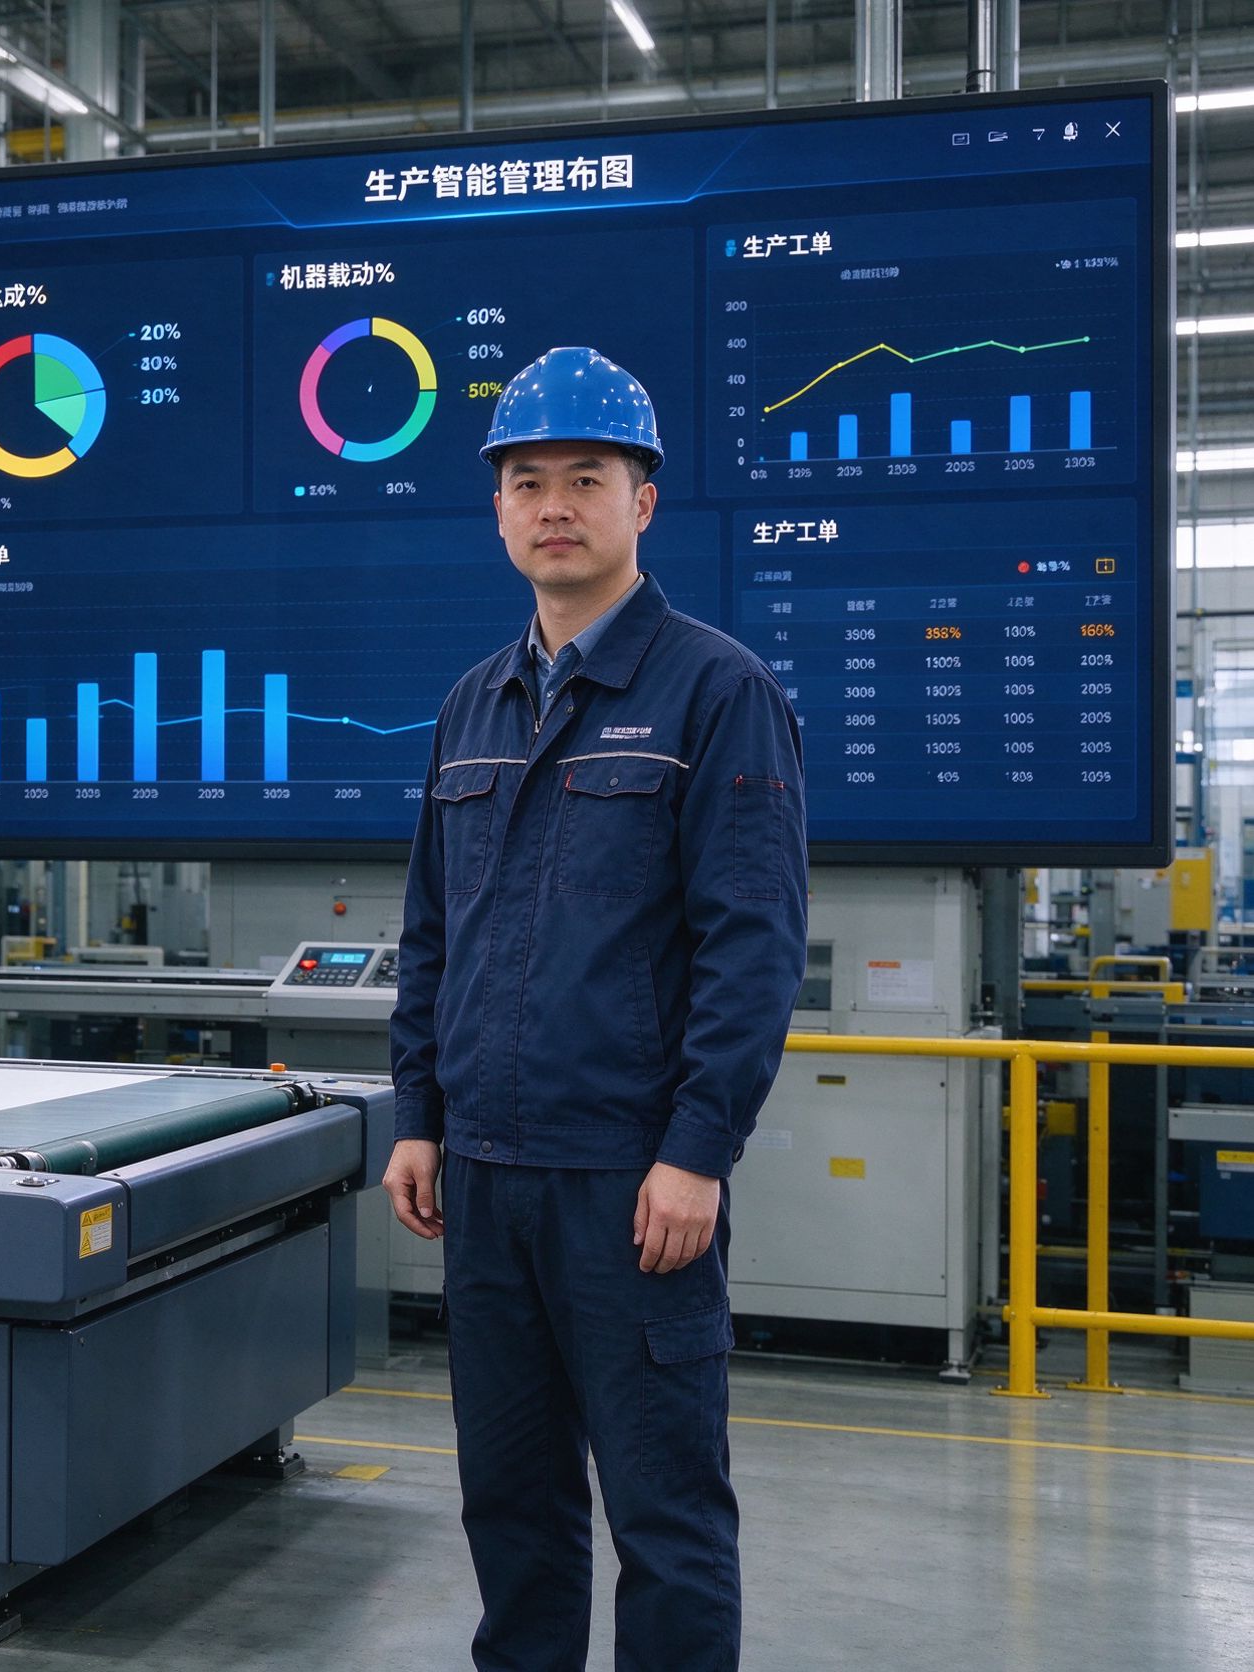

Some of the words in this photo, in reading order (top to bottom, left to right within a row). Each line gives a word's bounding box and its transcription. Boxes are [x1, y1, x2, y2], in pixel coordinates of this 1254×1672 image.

[365, 155, 633, 202] 生产智能管理布图
[743, 231, 832, 257] 生产工单
[467, 308, 505, 325] 60%
[141, 323, 181, 340] 20%
[468, 344, 503, 359] 60%
[141, 388, 179, 404] 30%
[729, 406, 745, 416] 20
[753, 519, 838, 543] 生产工单
